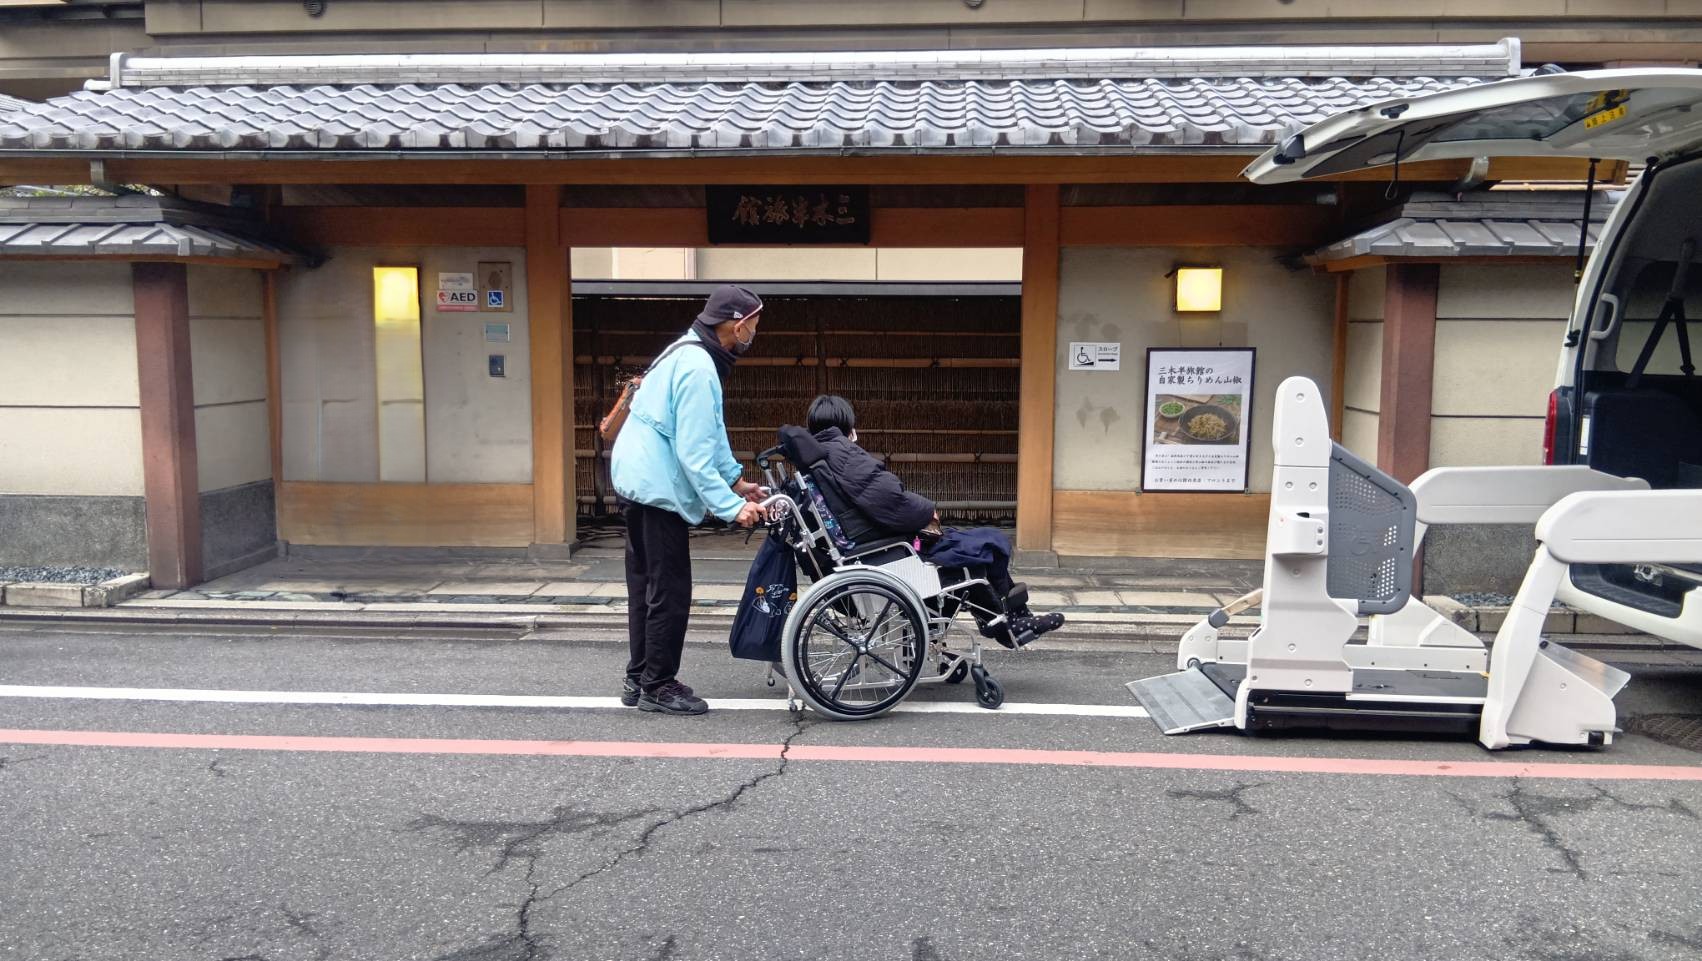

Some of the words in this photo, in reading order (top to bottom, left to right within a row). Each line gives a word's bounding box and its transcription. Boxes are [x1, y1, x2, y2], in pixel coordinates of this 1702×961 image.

[450, 292, 476, 302] AED
[1158, 375, 1243, 385] 自家製ちりめん山椒
